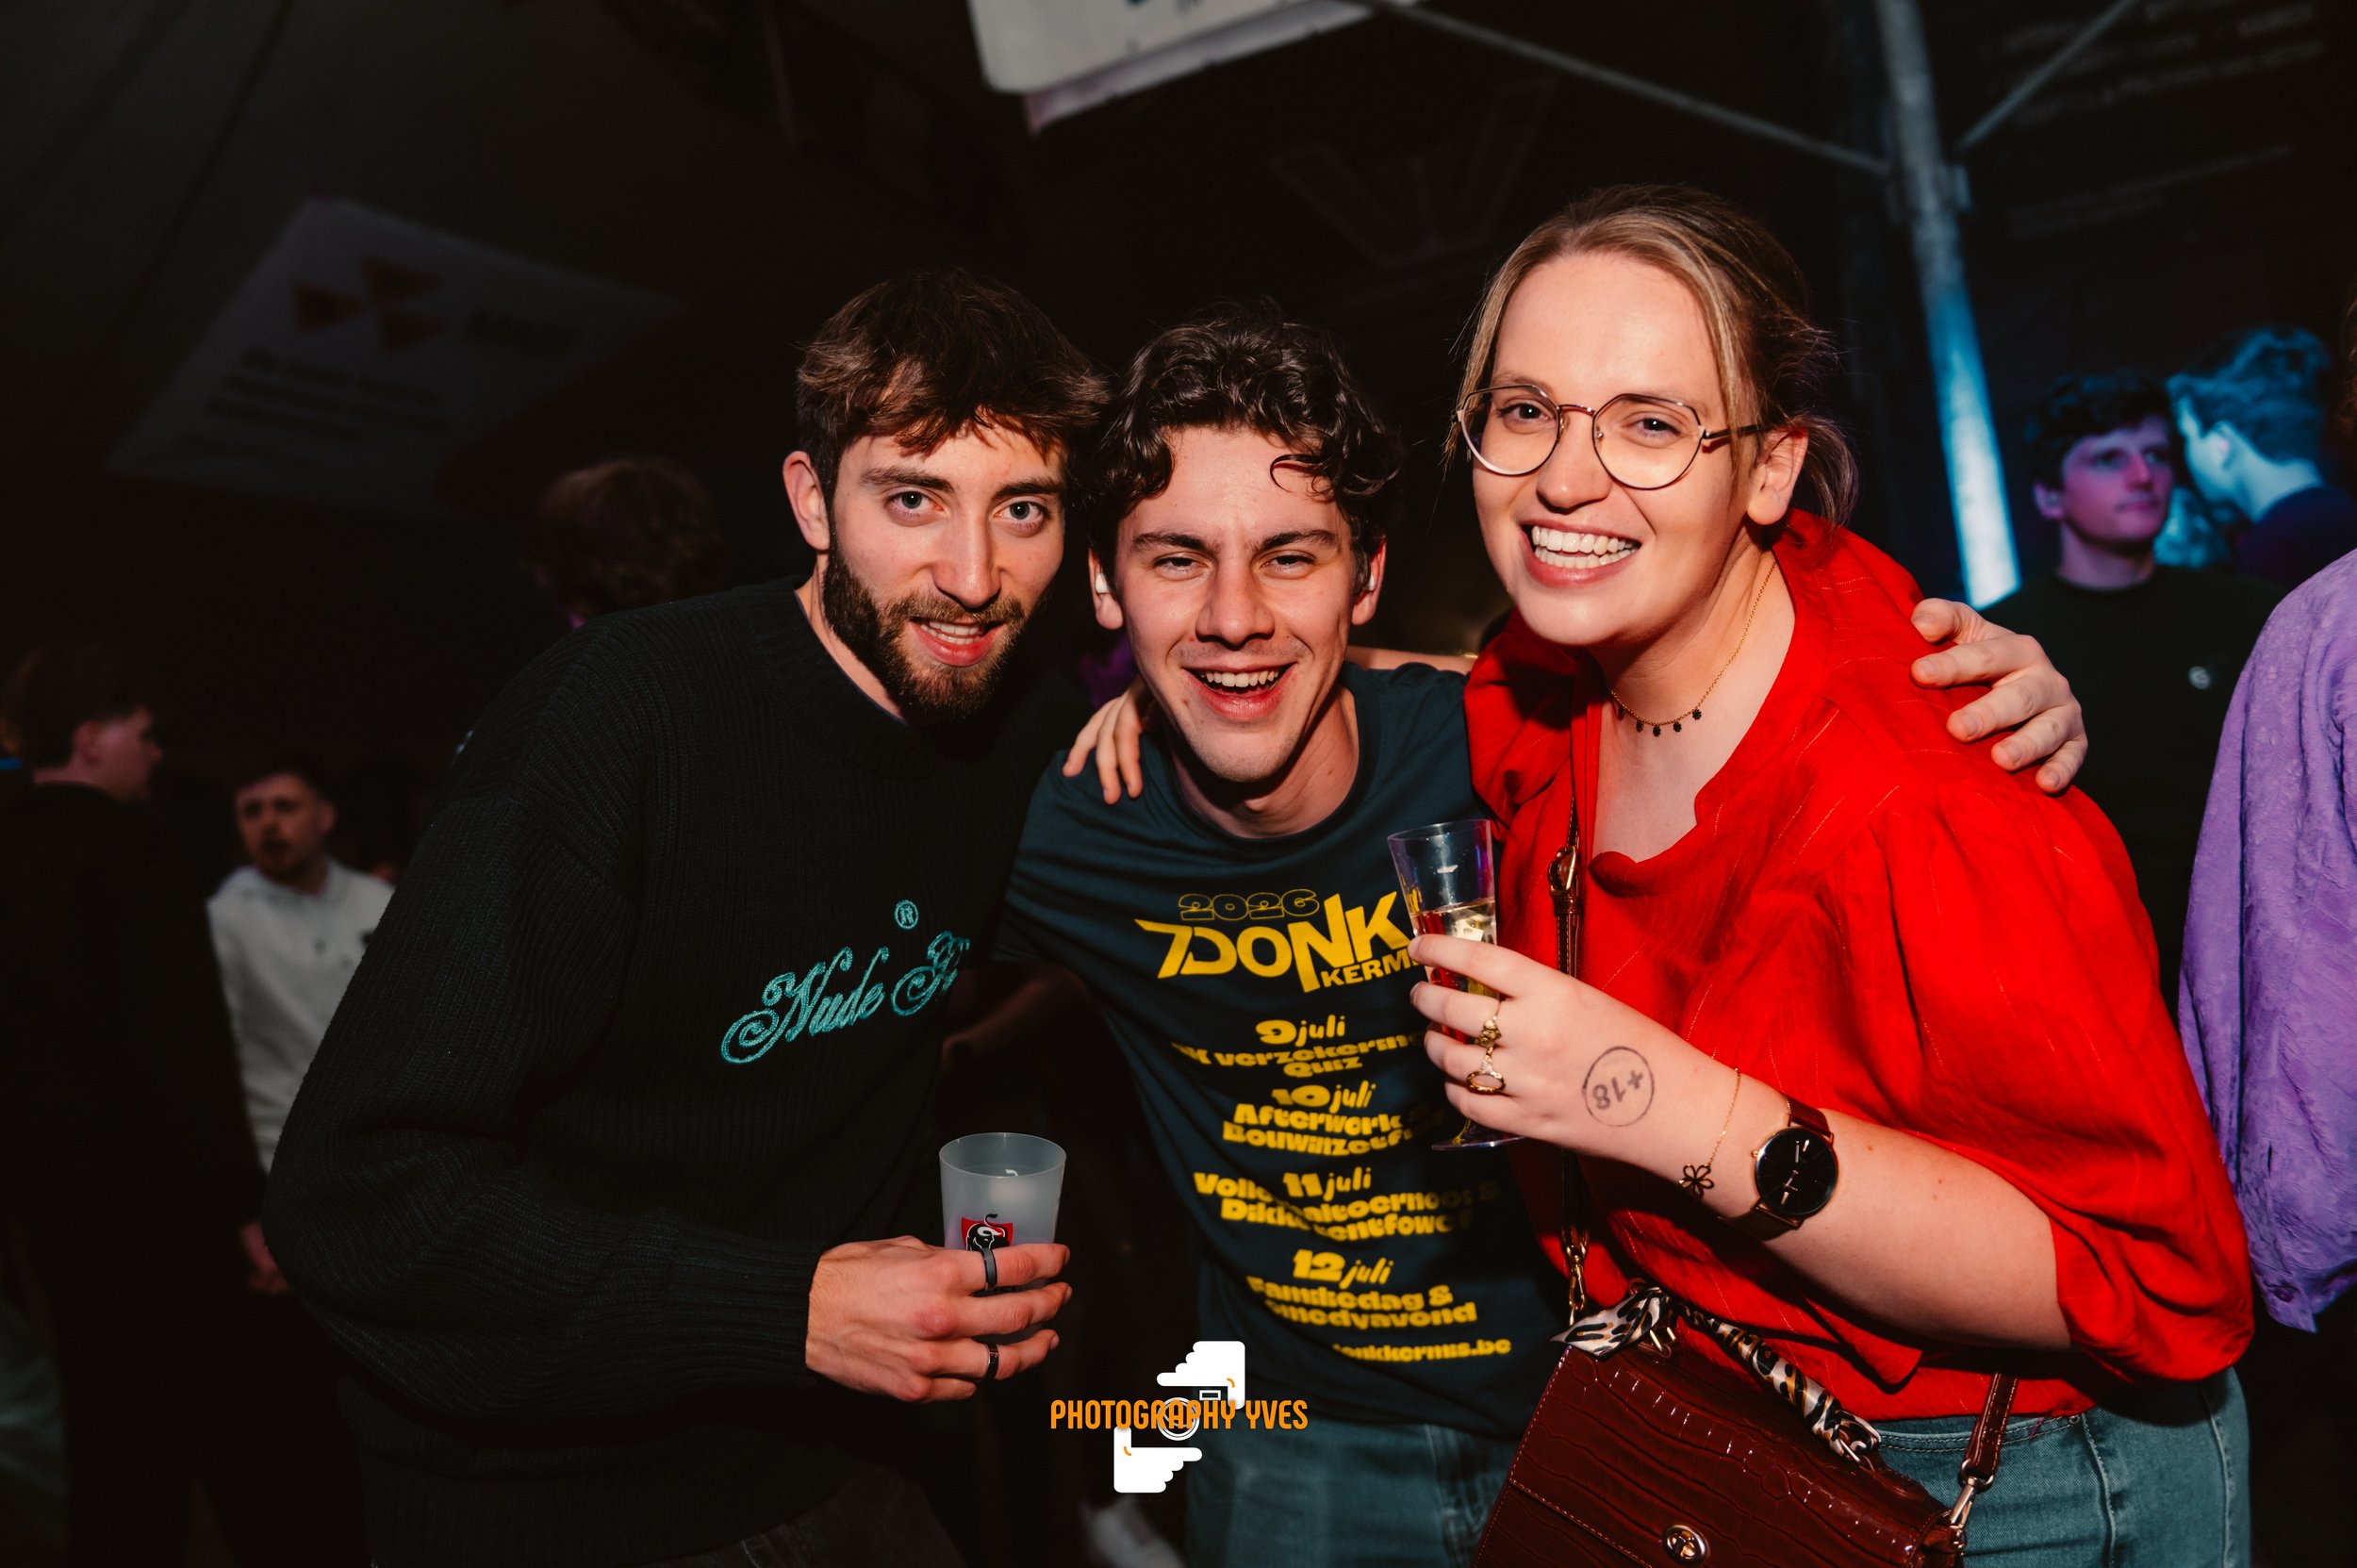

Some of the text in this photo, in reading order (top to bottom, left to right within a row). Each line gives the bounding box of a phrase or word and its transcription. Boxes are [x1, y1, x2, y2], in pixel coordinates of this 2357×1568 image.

[1178, 888, 1320, 921] 2026
[1320, 946, 1423, 988] KERM
[720, 945, 889, 1065] Nude
[1255, 1014, 1345, 1048] 9 juli
[1213, 1032, 1417, 1066] verzekerin
[1283, 1056, 1363, 1078] Quiz
[1272, 1080, 1376, 1114] 10 juli
[1233, 1102, 1403, 1135] Afterwork
[1283, 1166, 1372, 1201] 11 juli
[1293, 1248, 1393, 1289] 12 juli
[1428, 1284, 1454, 1307] &
[1265, 1299, 1477, 1329] omedyavond
